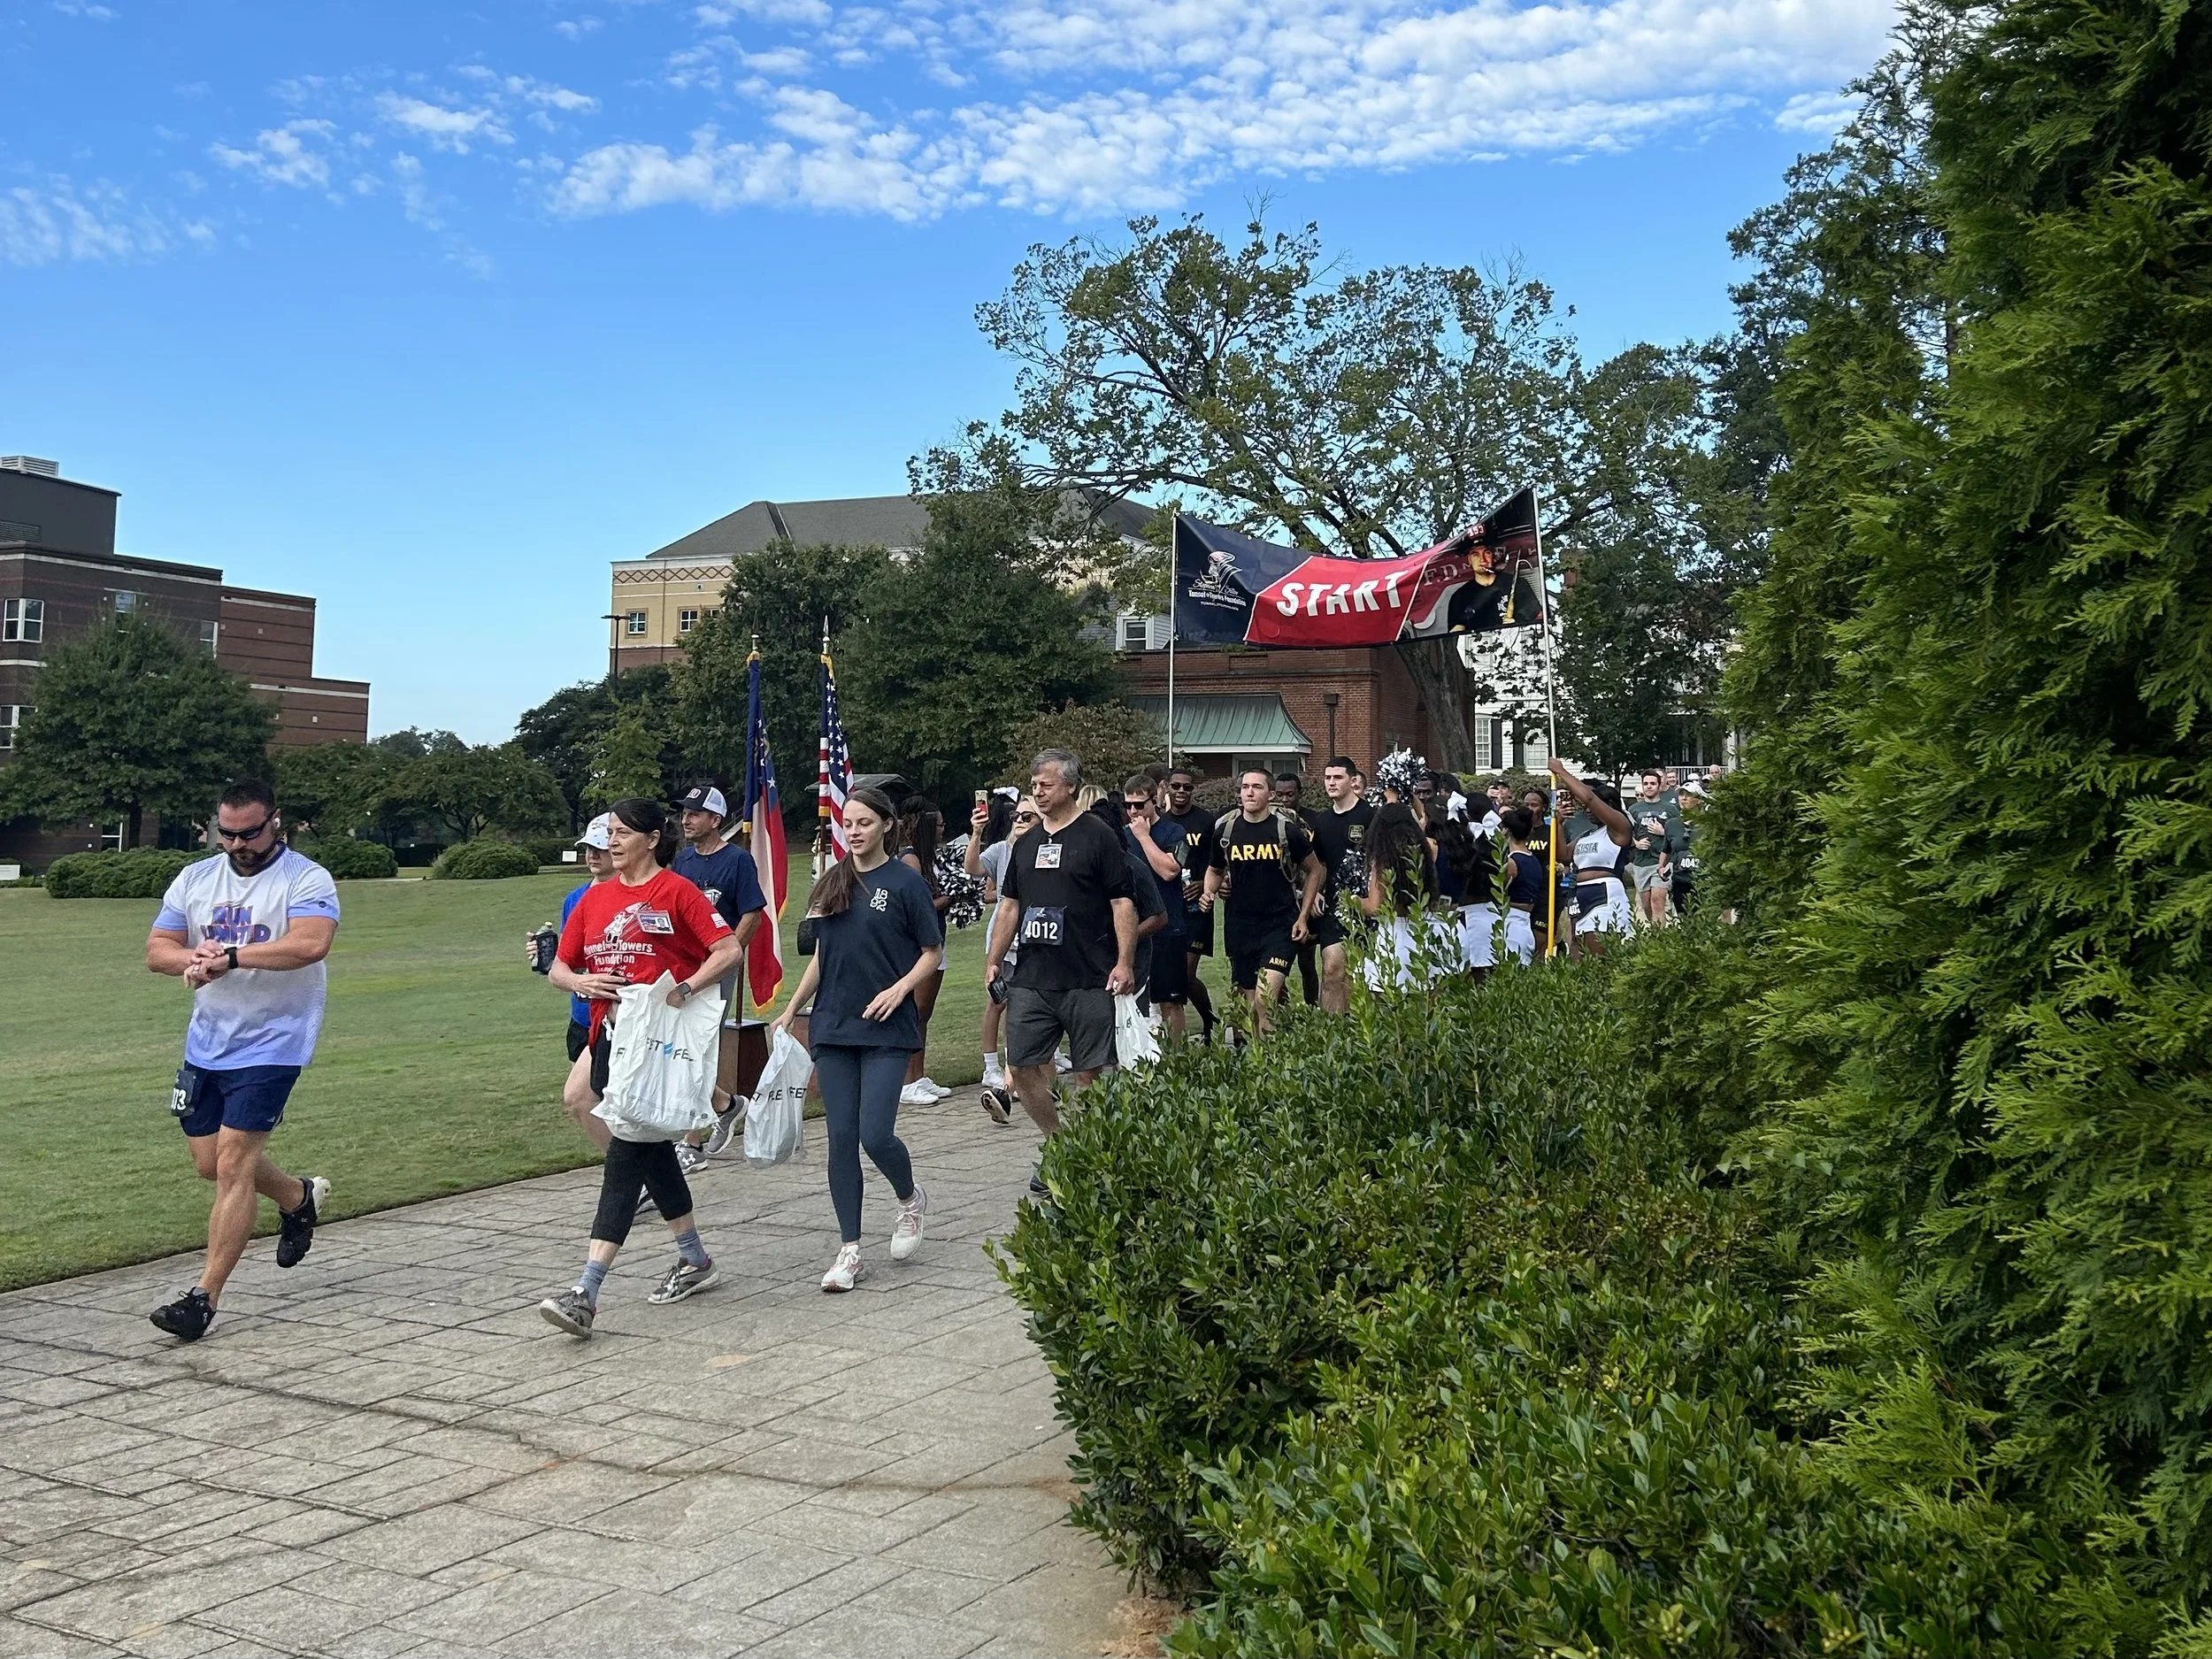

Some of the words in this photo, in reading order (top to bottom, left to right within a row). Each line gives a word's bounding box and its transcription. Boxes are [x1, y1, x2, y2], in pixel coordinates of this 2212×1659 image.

[1276, 570, 1409, 617] START
[1231, 843, 1282, 861] ARMY
[1525, 840, 1548, 850] MY
[1025, 921, 1058, 940] 4012
[618, 940, 653, 953] Towers
[1269, 956, 1288, 968] ARMY
